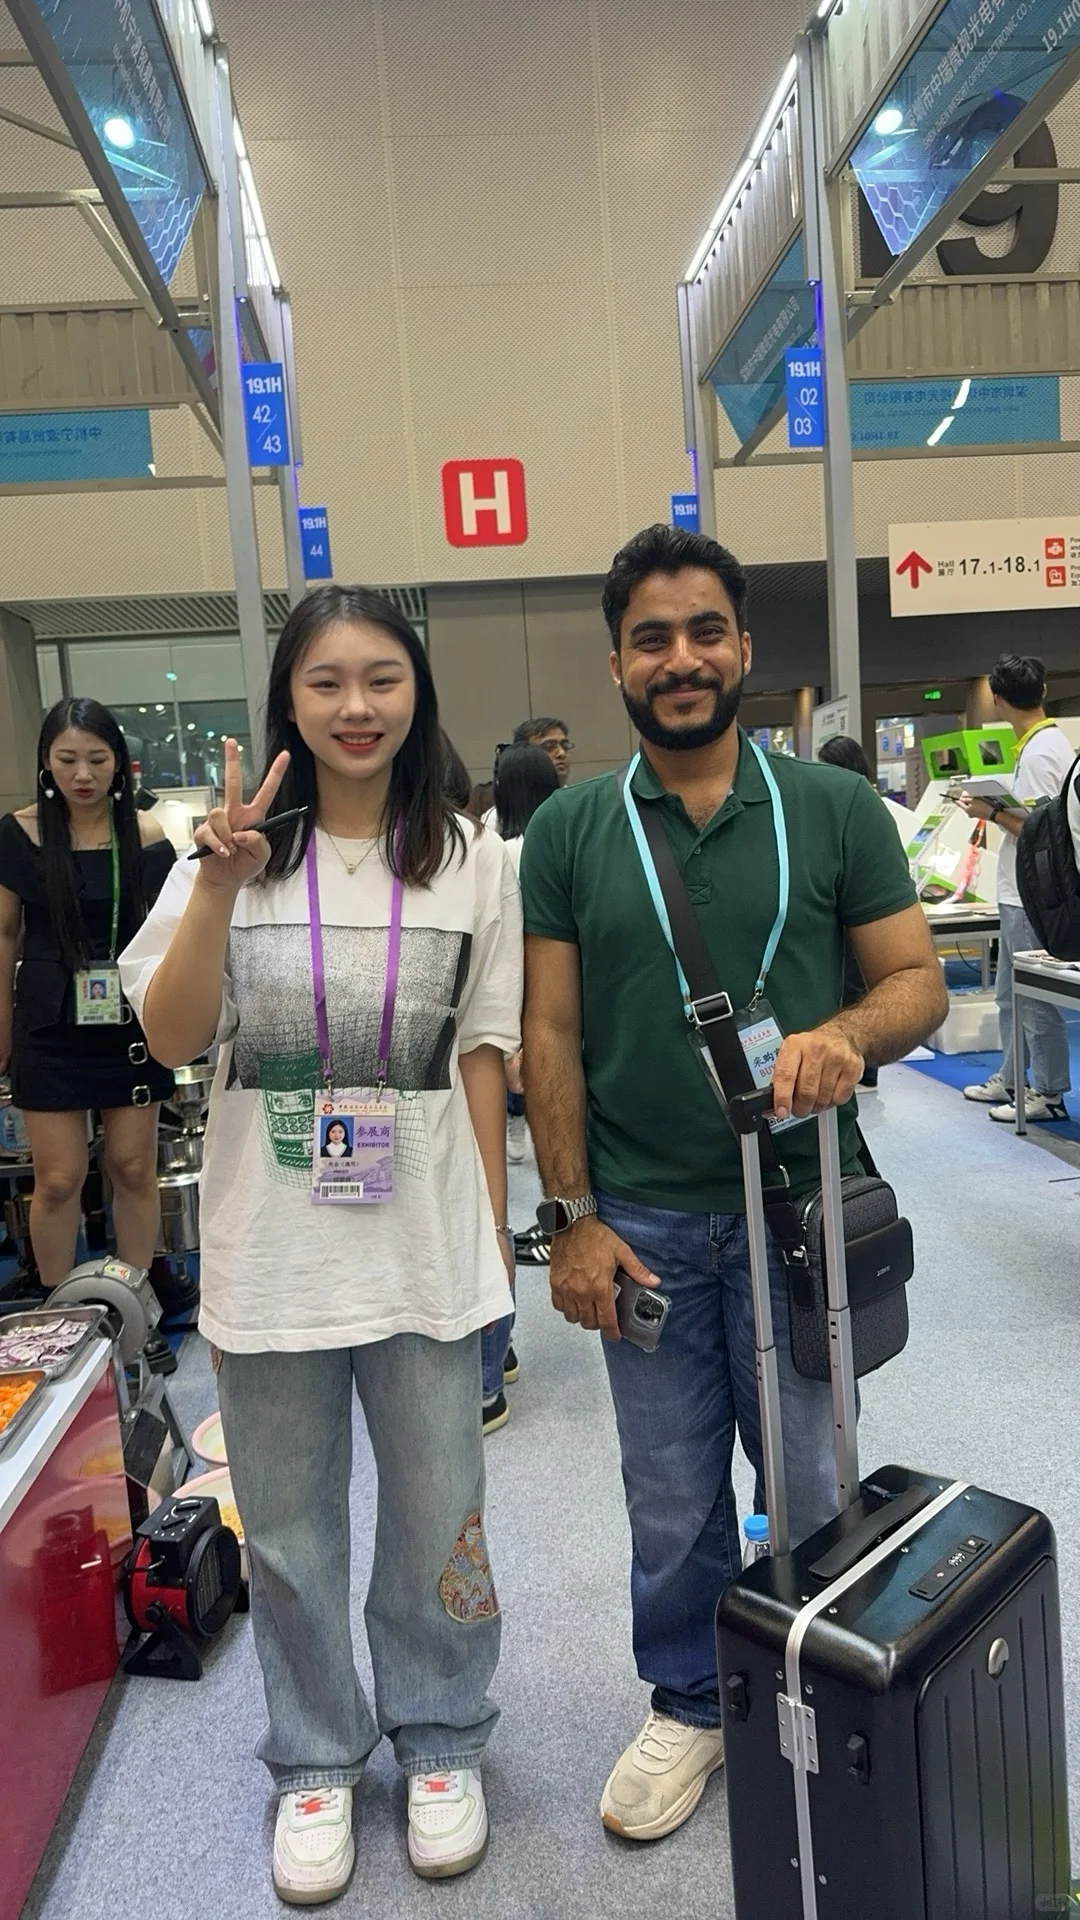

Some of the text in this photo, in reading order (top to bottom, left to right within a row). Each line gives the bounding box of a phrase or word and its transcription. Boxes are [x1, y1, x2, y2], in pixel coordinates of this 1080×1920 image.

[968, 15, 1018, 87] OPTOELECTRONIC
[114, 0, 171, 143] 机宁波贸易有限公司
[788, 361, 821, 377] 19.1H
[246, 376, 282, 394] 19.1H
[800, 388, 819, 405] 02
[252, 405, 271, 423] 42
[794, 417, 812, 435] 03
[263, 435, 282, 453] 43
[459, 471, 512, 536] H
[310, 545, 323, 557] 44
[938, 560, 955, 568] Hall
[356, 1126, 391, 1137] 参展商
